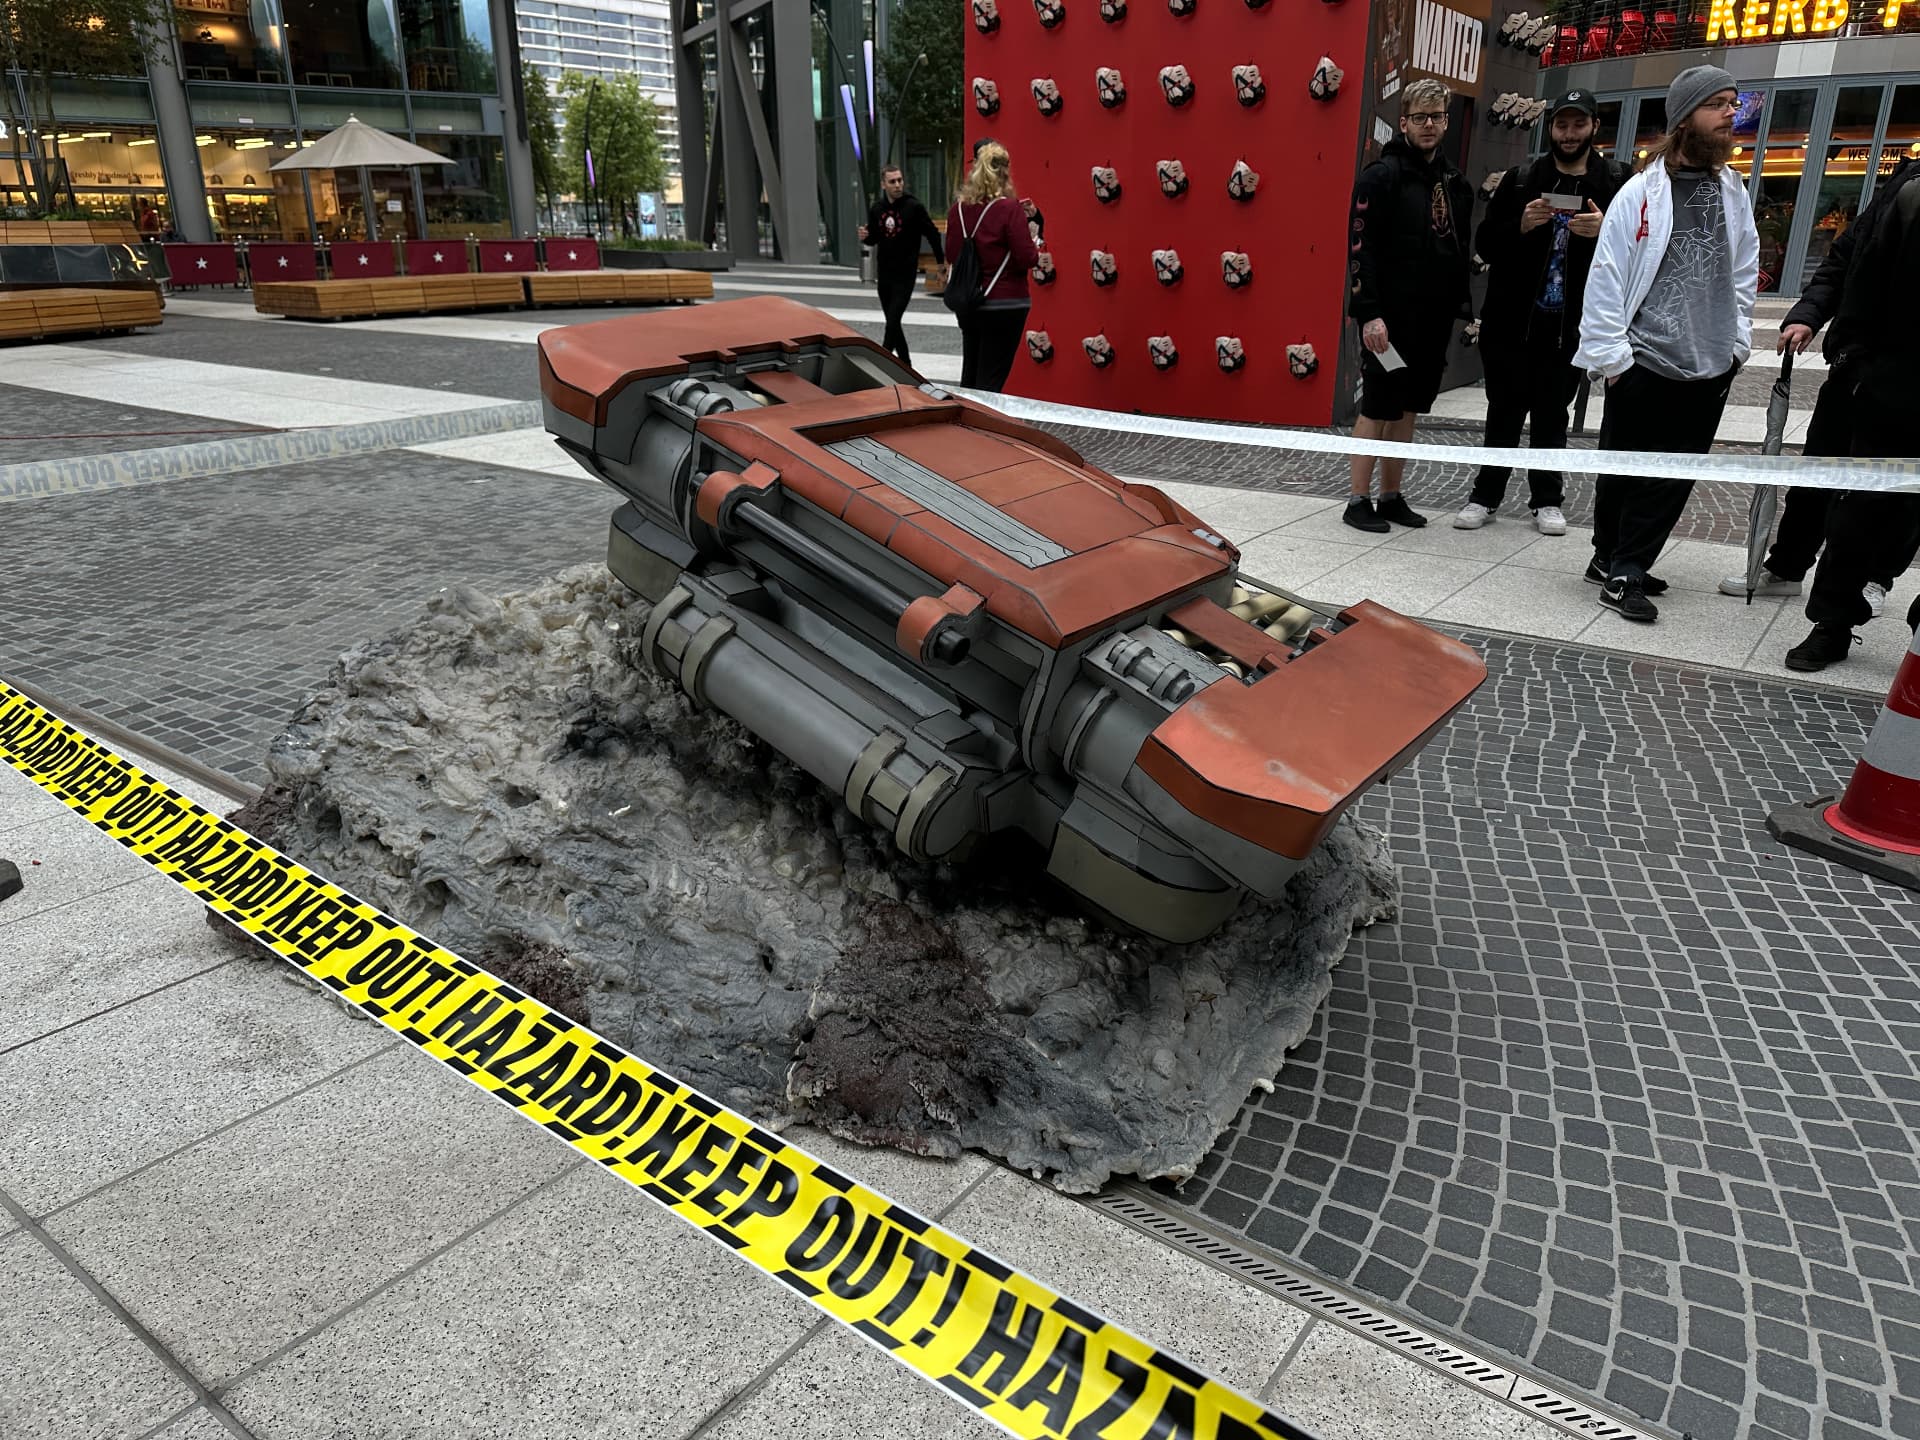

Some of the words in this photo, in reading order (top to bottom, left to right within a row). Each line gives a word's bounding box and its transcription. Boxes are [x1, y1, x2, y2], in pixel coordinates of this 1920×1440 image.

[1412, 0, 1483, 84] WANTED
[1706, 0, 1849, 41] KERB
[1848, 149, 1907, 161] WELOME
[53, 751, 132, 806] KEEP
[104, 785, 189, 842] OUT!
[154, 818, 302, 918] HAZARD!
[262, 887, 374, 961] KEEP
[346, 938, 467, 1024] OUT!
[430, 988, 665, 1150] HAZARD!
[624, 1103, 799, 1228] KEEP
[784, 1194, 972, 1349] OUT!
